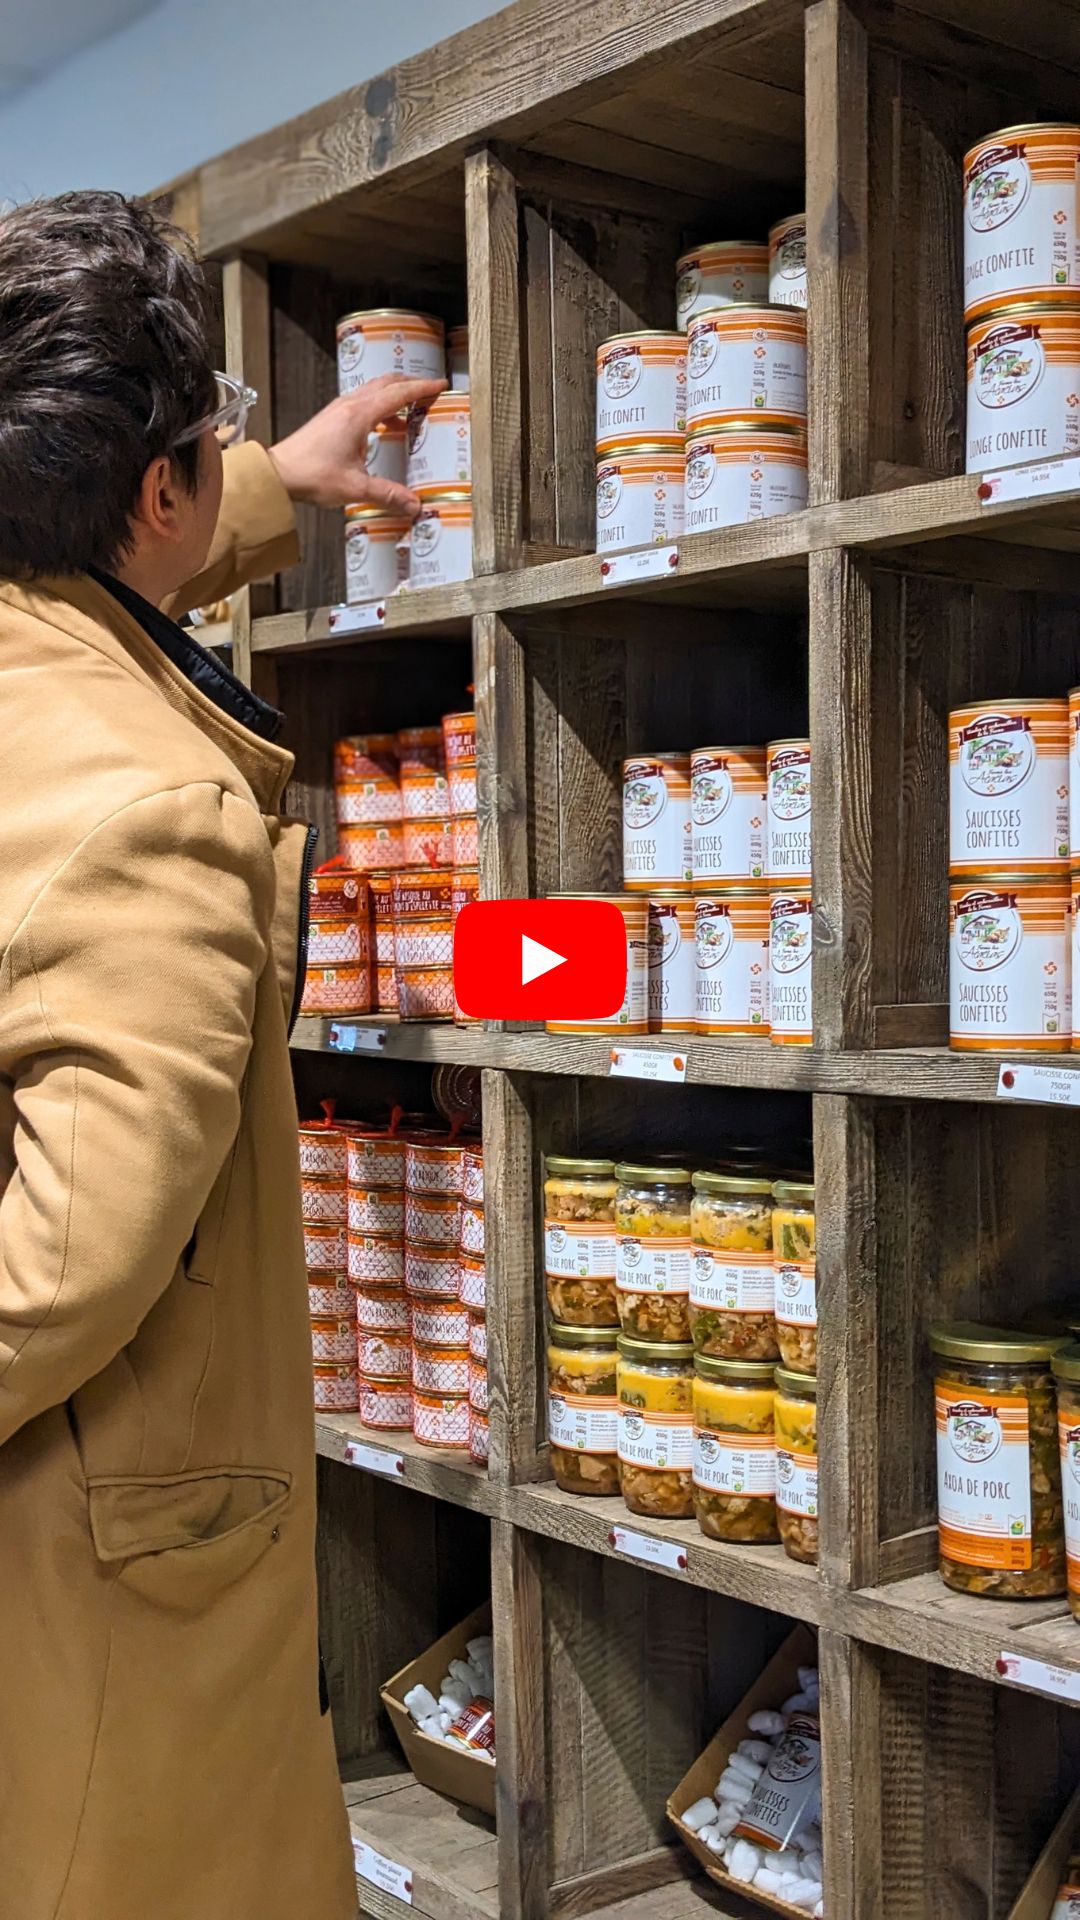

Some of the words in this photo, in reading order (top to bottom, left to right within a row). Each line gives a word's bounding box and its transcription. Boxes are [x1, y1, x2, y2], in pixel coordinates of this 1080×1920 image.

[986, 248, 1034, 274] CONFITE
[694, 384, 722, 406] CONFIT
[612, 406, 645, 426] CONFIT
[996, 428, 1048, 452] CONFITE
[690, 507, 718, 526] CONFIT
[600, 526, 625, 544] CONFIT
[966, 808, 1021, 829] SAUCISSES
[966, 830, 1020, 848] CONFITES
[959, 982, 1008, 1002] SAUCISSES
[960, 1004, 1008, 1023] CONFITES
[554, 1257, 560, 1268] DE
[561, 1257, 576, 1270] PORC
[628, 1272, 635, 1284] DE
[636, 1272, 652, 1285] PORC
[699, 1287, 706, 1298] DE
[706, 1288, 722, 1302] PORC
[786, 1302, 794, 1314] DE
[796, 1303, 812, 1317] PORC
[555, 1428, 560, 1438] DE
[560, 1428, 574, 1442] PORC
[630, 1444, 636, 1456] DE
[638, 1445, 653, 1460] PORC
[704, 1468, 712, 1480] DE
[712, 1469, 730, 1485] PORC
[944, 1471, 963, 1494] AXOA
[967, 1478, 979, 1496] DE
[984, 1480, 1011, 1500] PORC
[782, 1488, 788, 1501] DE
[788, 1490, 804, 1506] PORC
